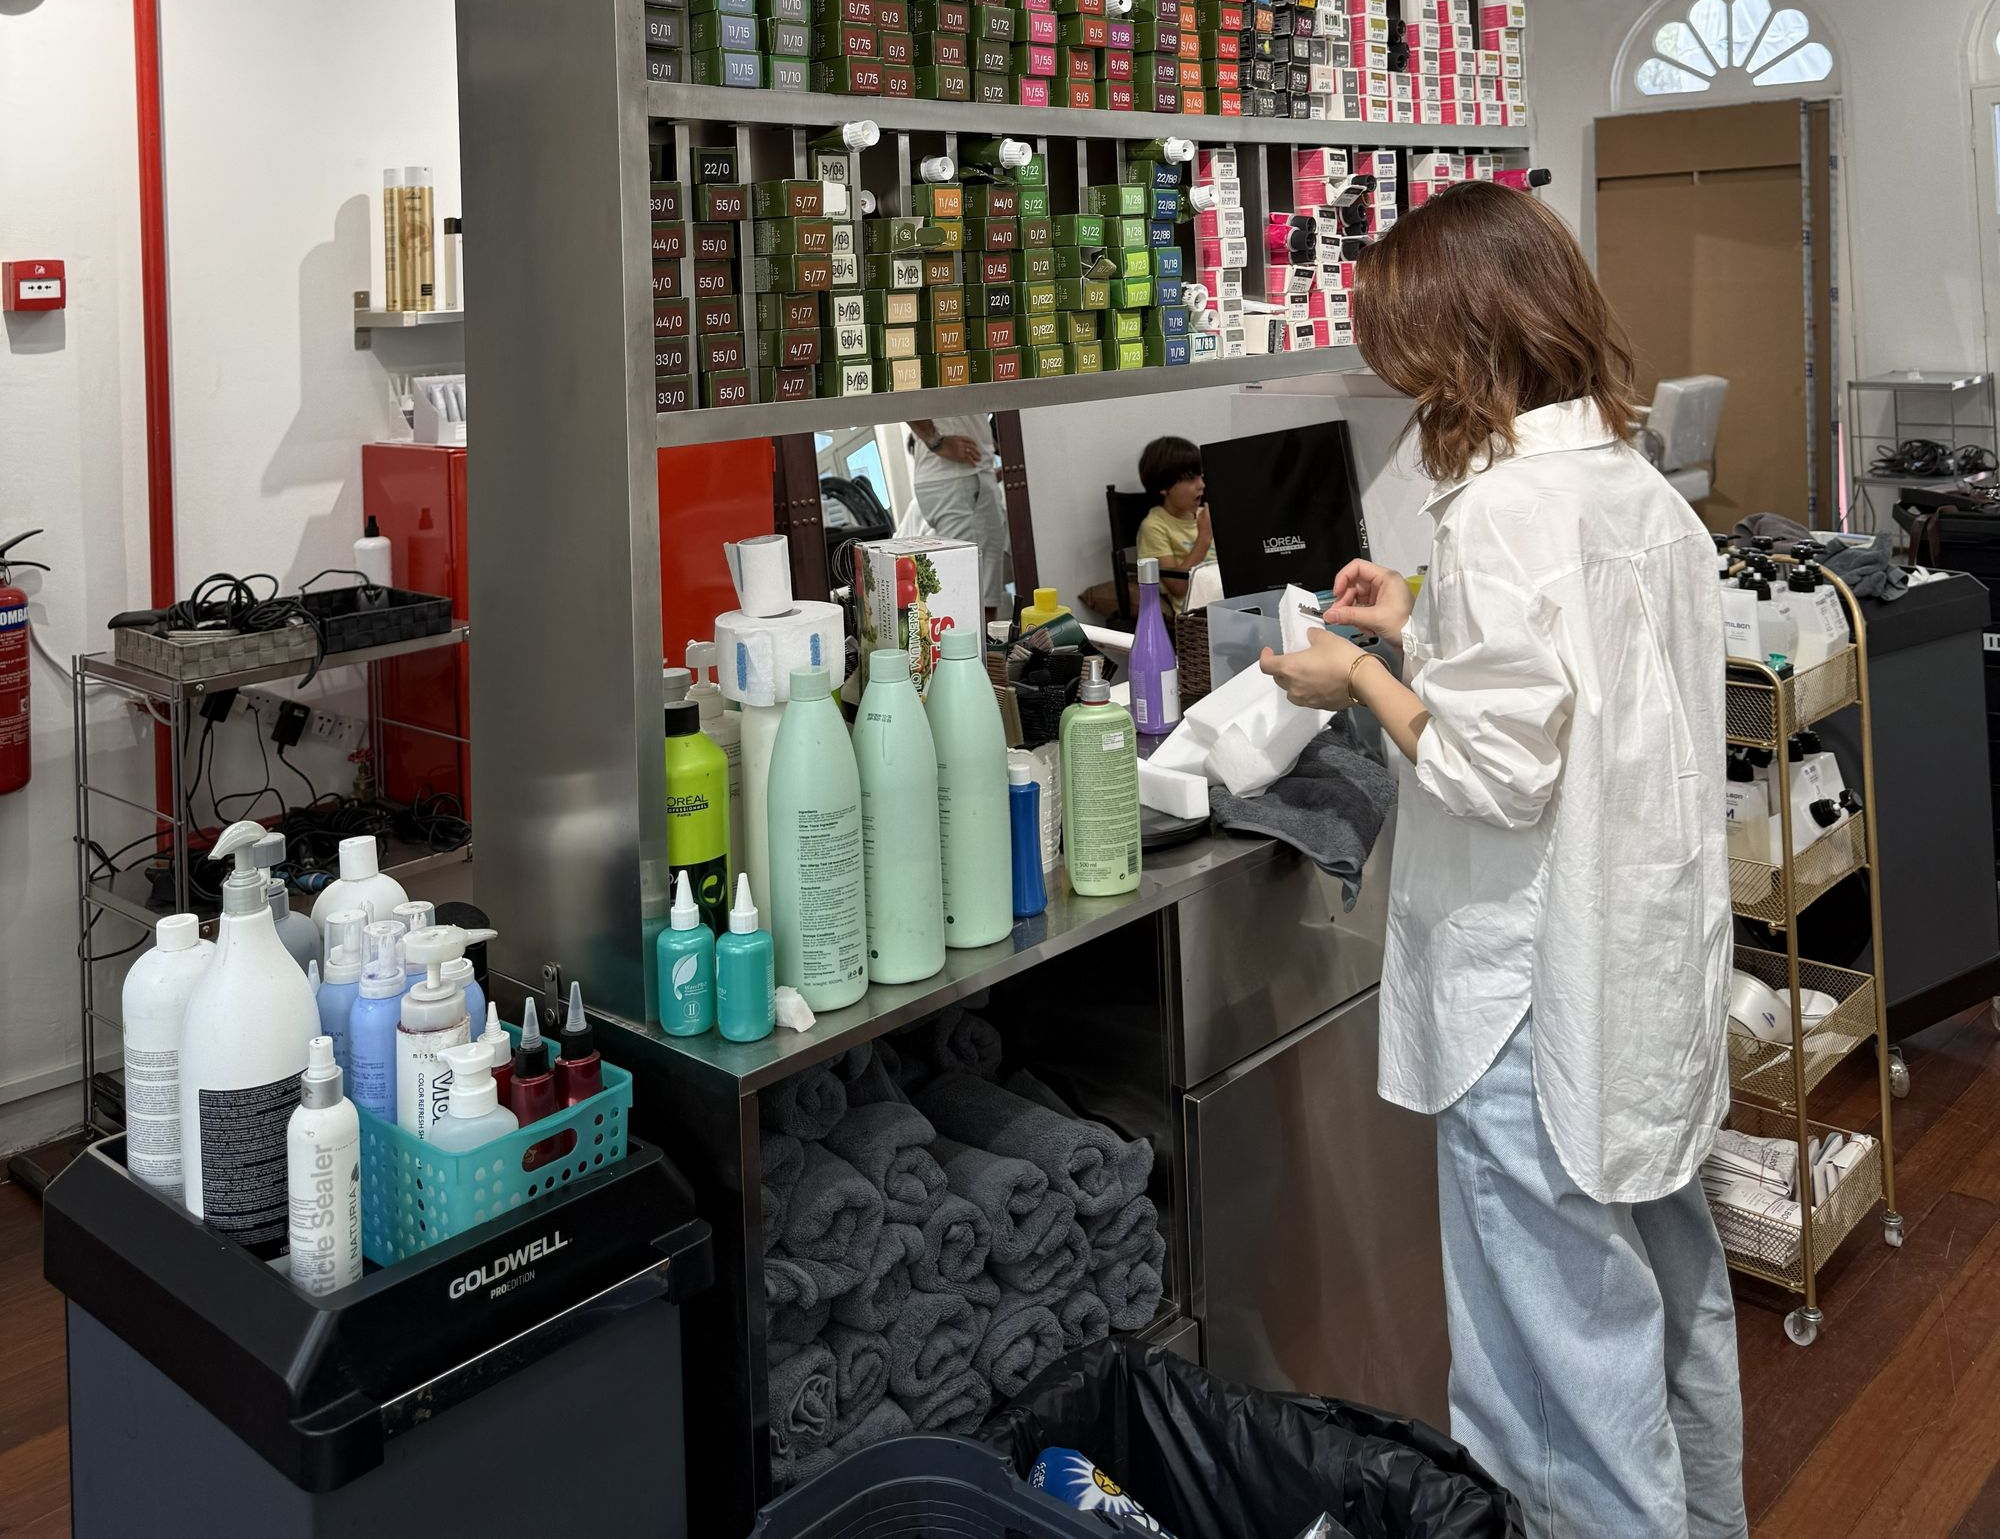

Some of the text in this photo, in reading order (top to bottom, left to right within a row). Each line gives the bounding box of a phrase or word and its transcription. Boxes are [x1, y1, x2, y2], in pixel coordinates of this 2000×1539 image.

[849, 3, 870, 16] G/75
[881, 11, 899, 23] G/3
[1181, 14, 1193, 24] /43
[650, 22, 671, 37] 6/11
[991, 19, 1009, 30] G/72
[728, 24, 750, 39] 11/15
[783, 34, 803, 48] 11/10
[849, 37, 871, 50] G/75
[889, 45, 905, 57] G/3
[985, 54, 1003, 65] G/72
[652, 63, 672, 76] 6/11
[732, 62, 753, 76] 11/15
[780, 70, 801, 84] 11/10
[856, 72, 879, 85] G/75
[890, 79, 907, 91] G/3
[984, 87, 1003, 98] G/72
[705, 163, 730, 176] 22/0
[716, 199, 740, 212] 55/0
[795, 196, 817, 209] 5/77
[939, 198, 958, 209] 11/48
[994, 198, 1013, 209] 44/0
[1024, 200, 1043, 211] S/22
[992, 232, 1012, 243] 44/0
[1082, 226, 1100, 237] S/22
[653, 238, 679, 252] 44/0
[702, 239, 727, 252] 55/0
[804, 233, 826, 247] D/77
[804, 270, 826, 282] 5/77
[931, 266, 949, 279] 9/13
[652, 277, 672, 291] 4/0
[699, 277, 724, 290] 55/0
[991, 295, 1010, 307] 22/0
[1090, 291, 1104, 302] 6/2
[940, 300, 957, 312] 9/13
[706, 313, 731, 326] 55/0
[792, 307, 812, 320] 5/77
[656, 315, 682, 330] 44/0
[1076, 323, 1090, 333] 6/2
[941, 332, 959, 345] 11/17
[992, 330, 1009, 342] 7/77
[712, 349, 737, 363] 55/0
[790, 343, 812, 357] 4/77
[656, 352, 682, 366] 33/0
[1083, 353, 1096, 365] 6/2
[946, 366, 964, 378] 11/17
[999, 363, 1015, 375] 7/77
[783, 379, 804, 392] 4/77
[658, 391, 684, 405] 33/0
[720, 386, 744, 400] 55/0
[908, 603, 920, 671] PREMIUM
[667, 794, 708, 807] ORÉAL
[310, 1145, 335, 1229] Sealer
